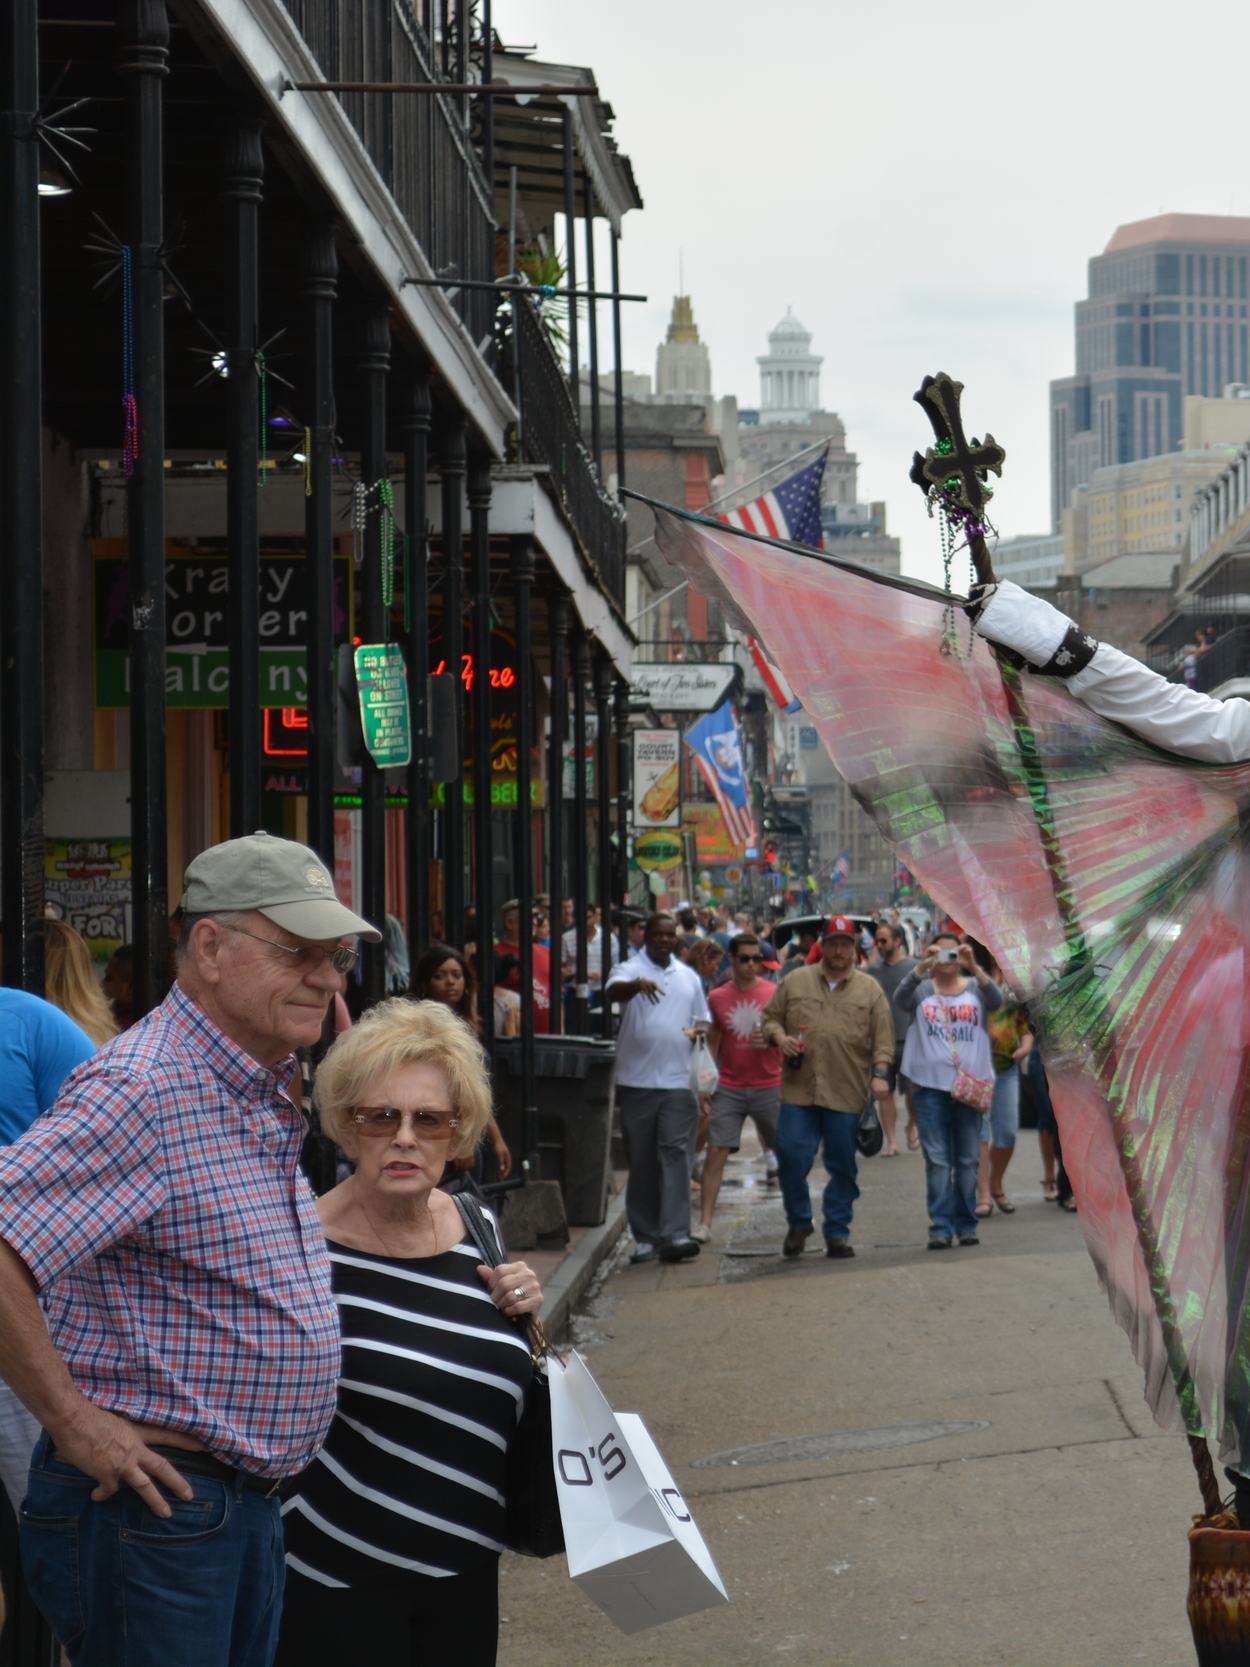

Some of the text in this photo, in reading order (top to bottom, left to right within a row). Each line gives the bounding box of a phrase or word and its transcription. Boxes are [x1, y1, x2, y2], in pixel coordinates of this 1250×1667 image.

[165, 563, 293, 602] Kray
[172, 610, 307, 637] orer
[124, 655, 307, 701] alcny
[265, 775, 303, 792] ALL
[72, 913, 121, 940] FOR
